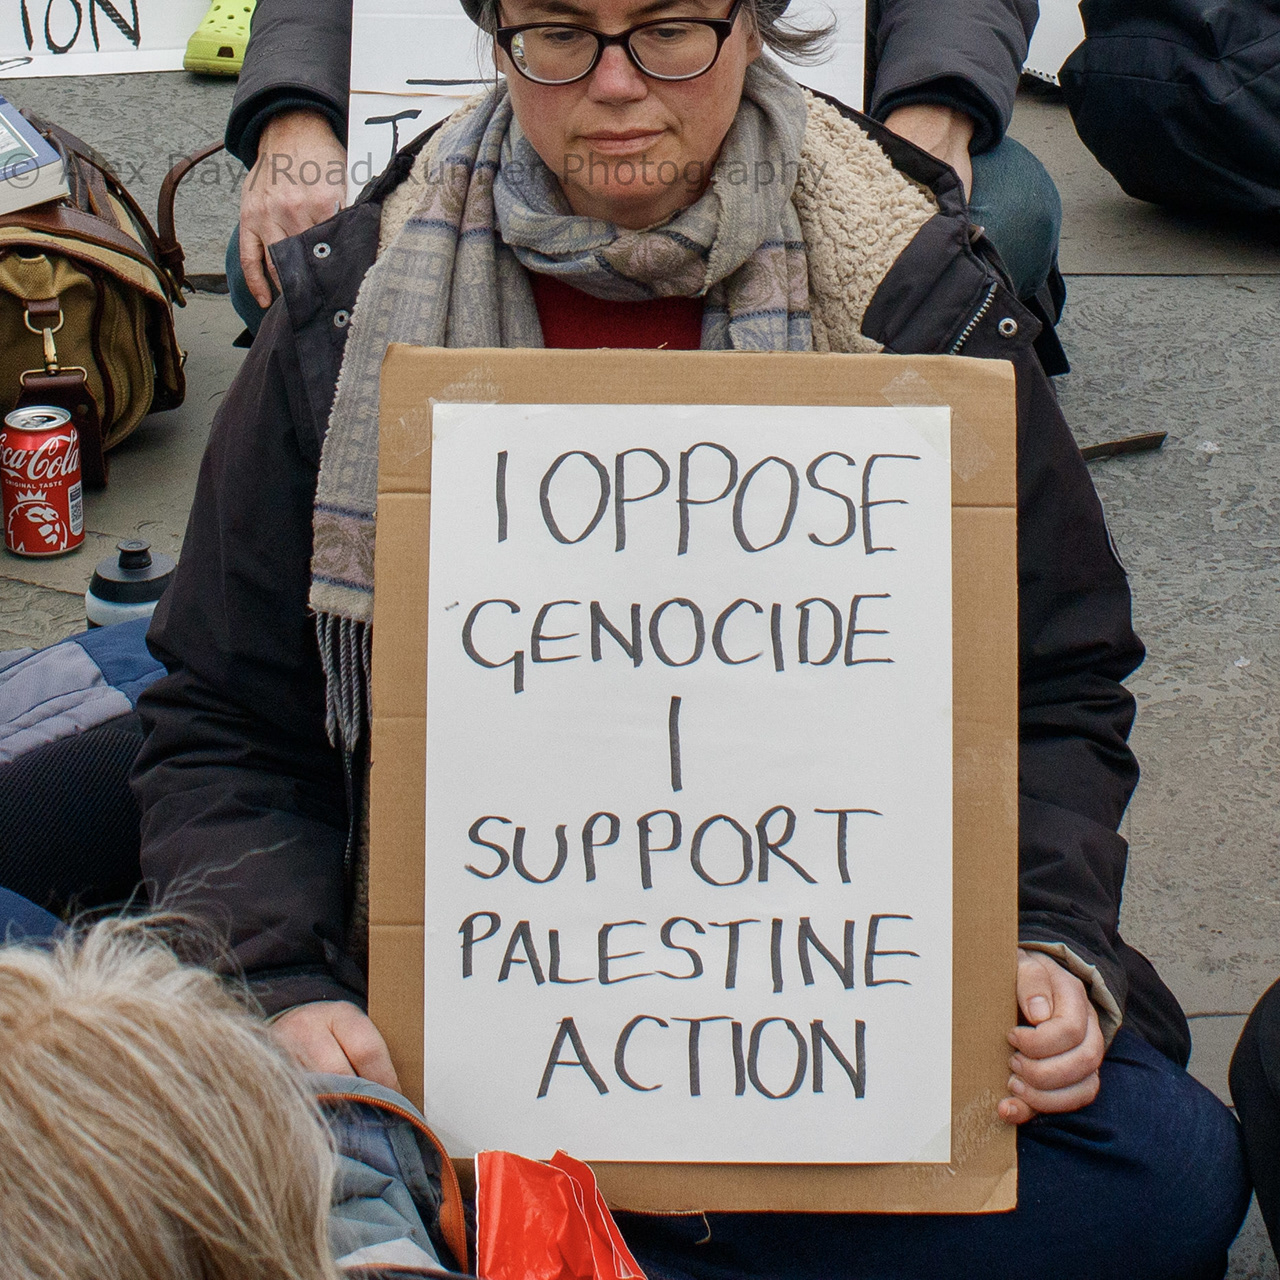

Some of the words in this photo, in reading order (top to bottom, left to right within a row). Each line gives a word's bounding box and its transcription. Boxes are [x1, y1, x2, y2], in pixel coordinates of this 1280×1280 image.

[5, 478, 37, 489] ORIGINAL
[39, 480, 63, 489] TASTE
[498, 450, 508, 543] I
[539, 441, 922, 556] OPPOSE
[461, 593, 896, 695] GENOCIDE
[668, 695, 683, 792] I
[464, 805, 884, 890] SUPPORT
[458, 910, 921, 994] PALESTINE
[536, 1013, 867, 1100] ACTION
